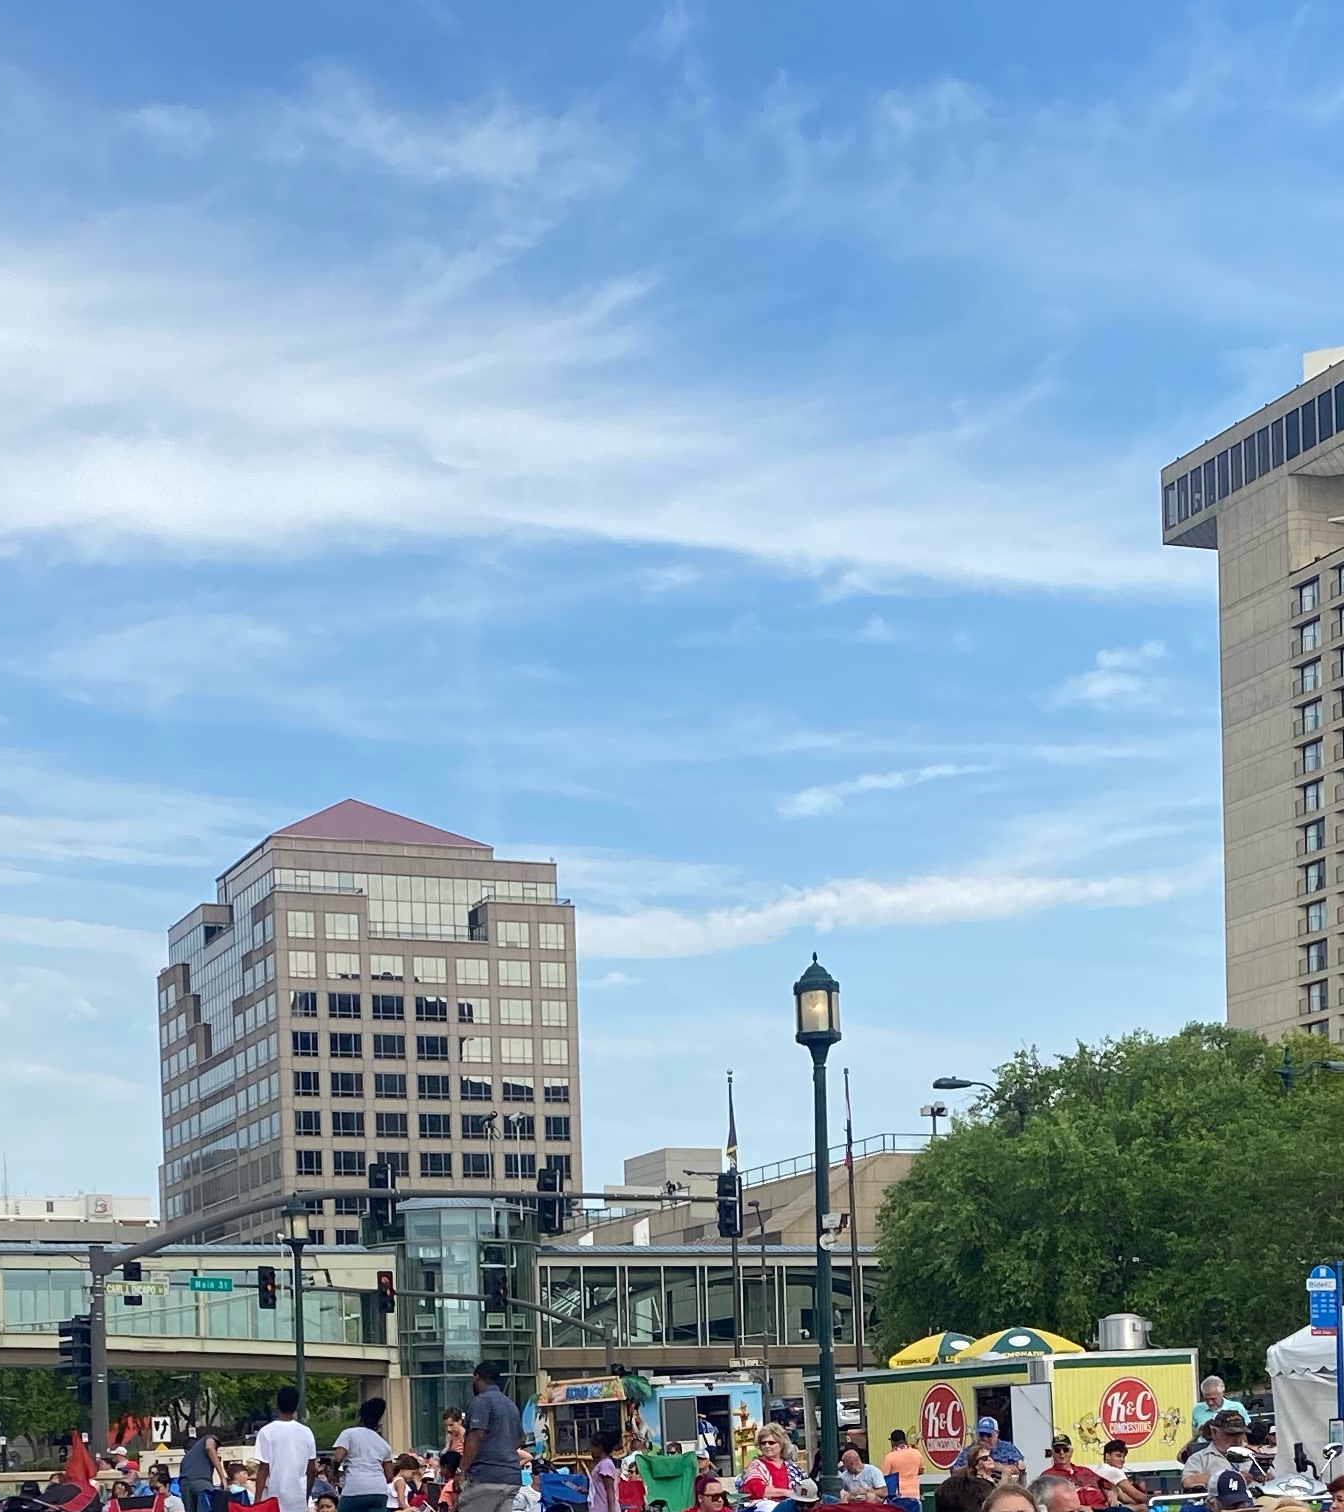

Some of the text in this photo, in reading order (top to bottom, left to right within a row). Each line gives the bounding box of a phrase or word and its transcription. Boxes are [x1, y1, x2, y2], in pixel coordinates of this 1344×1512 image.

[194, 1280, 228, 1290] Main St
[924, 1400, 962, 1438] K&C
[1107, 1390, 1152, 1422] K&C
